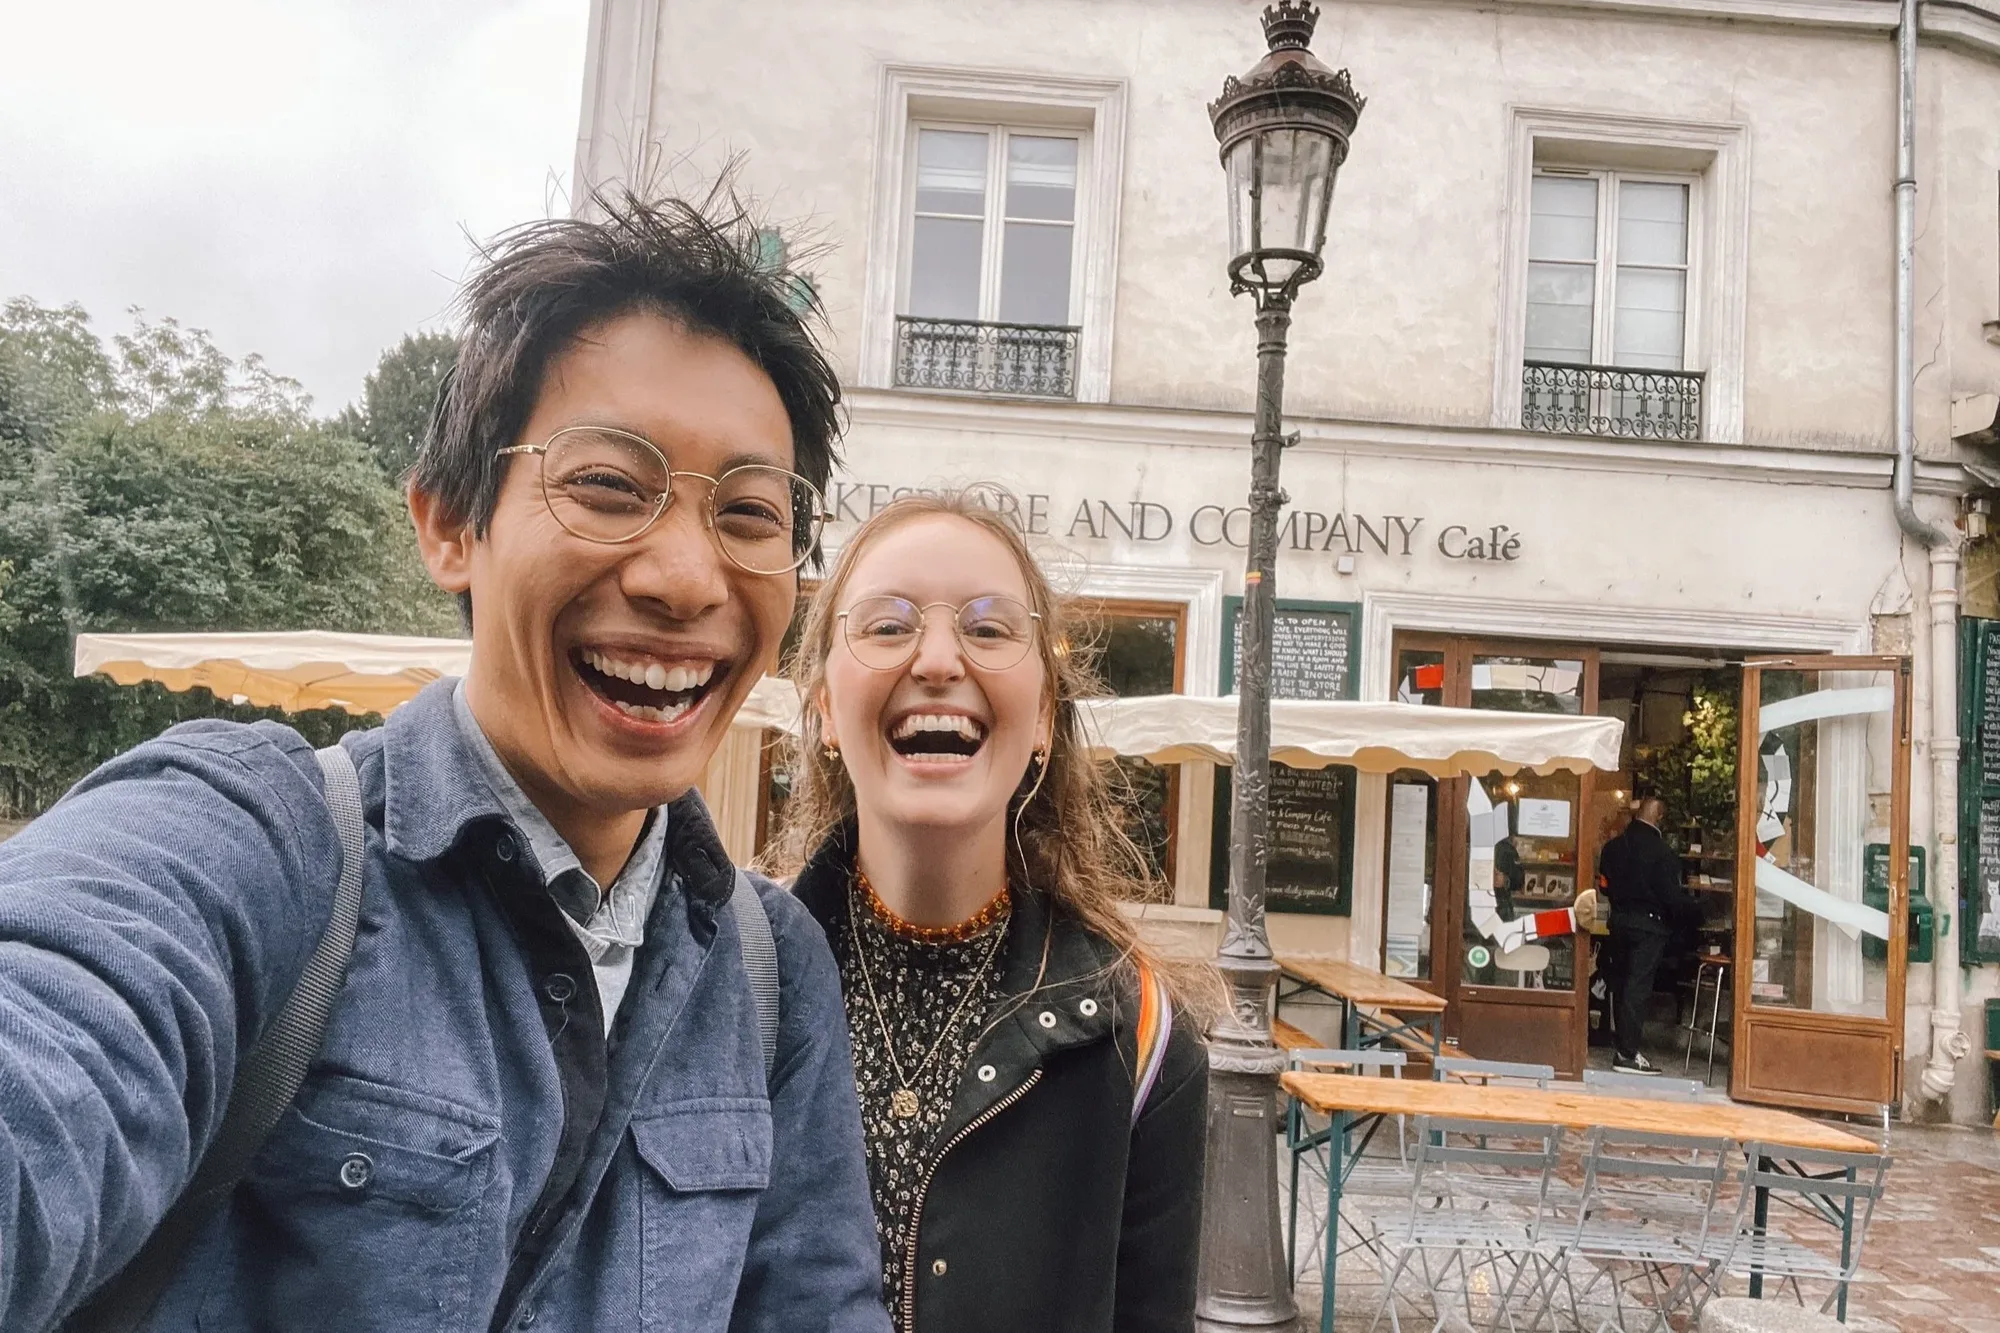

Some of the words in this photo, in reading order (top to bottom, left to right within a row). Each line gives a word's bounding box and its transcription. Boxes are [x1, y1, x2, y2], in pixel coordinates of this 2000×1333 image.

[835, 482, 1050, 535] KERE
[1066, 498, 1173, 542] AND
[1189, 505, 1424, 555] COMPANY
[1437, 525, 1521, 560] Café
[1301, 618, 1326, 626] OPEN
[1304, 671, 1341, 680] ENOUGH
[1280, 678, 1295, 686] BUY
[1313, 681, 1341, 691] STORE
